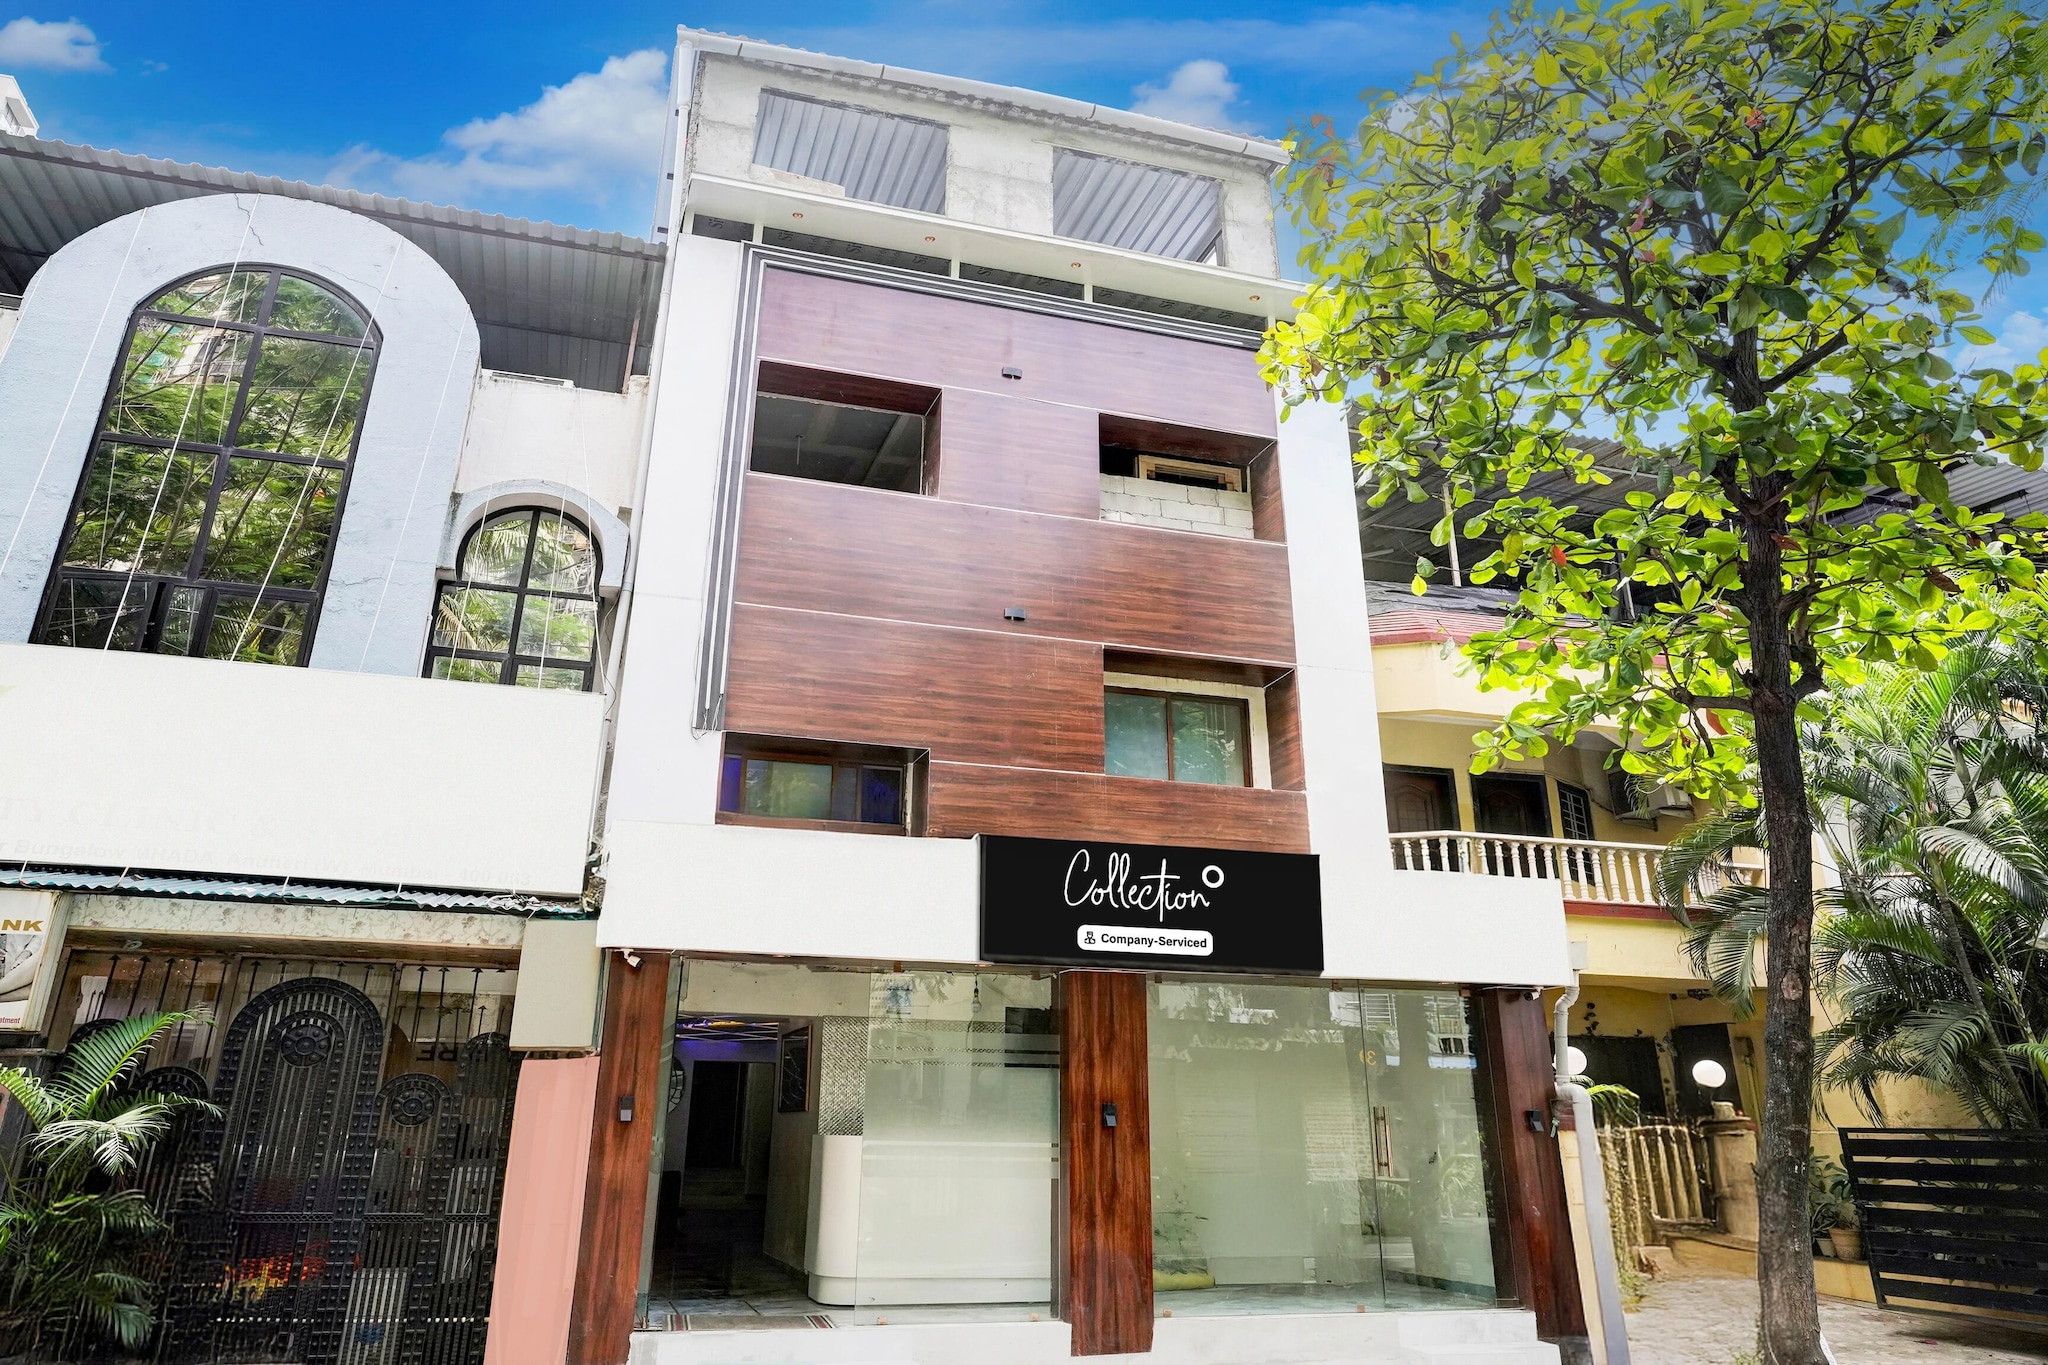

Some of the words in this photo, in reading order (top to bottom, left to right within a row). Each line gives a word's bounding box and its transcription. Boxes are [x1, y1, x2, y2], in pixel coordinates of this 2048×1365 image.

[14, 838, 125, 861] Bungalow
[1064, 848, 1211, 923] Collection
[1100, 932, 1208, 949] Company-Serviced
